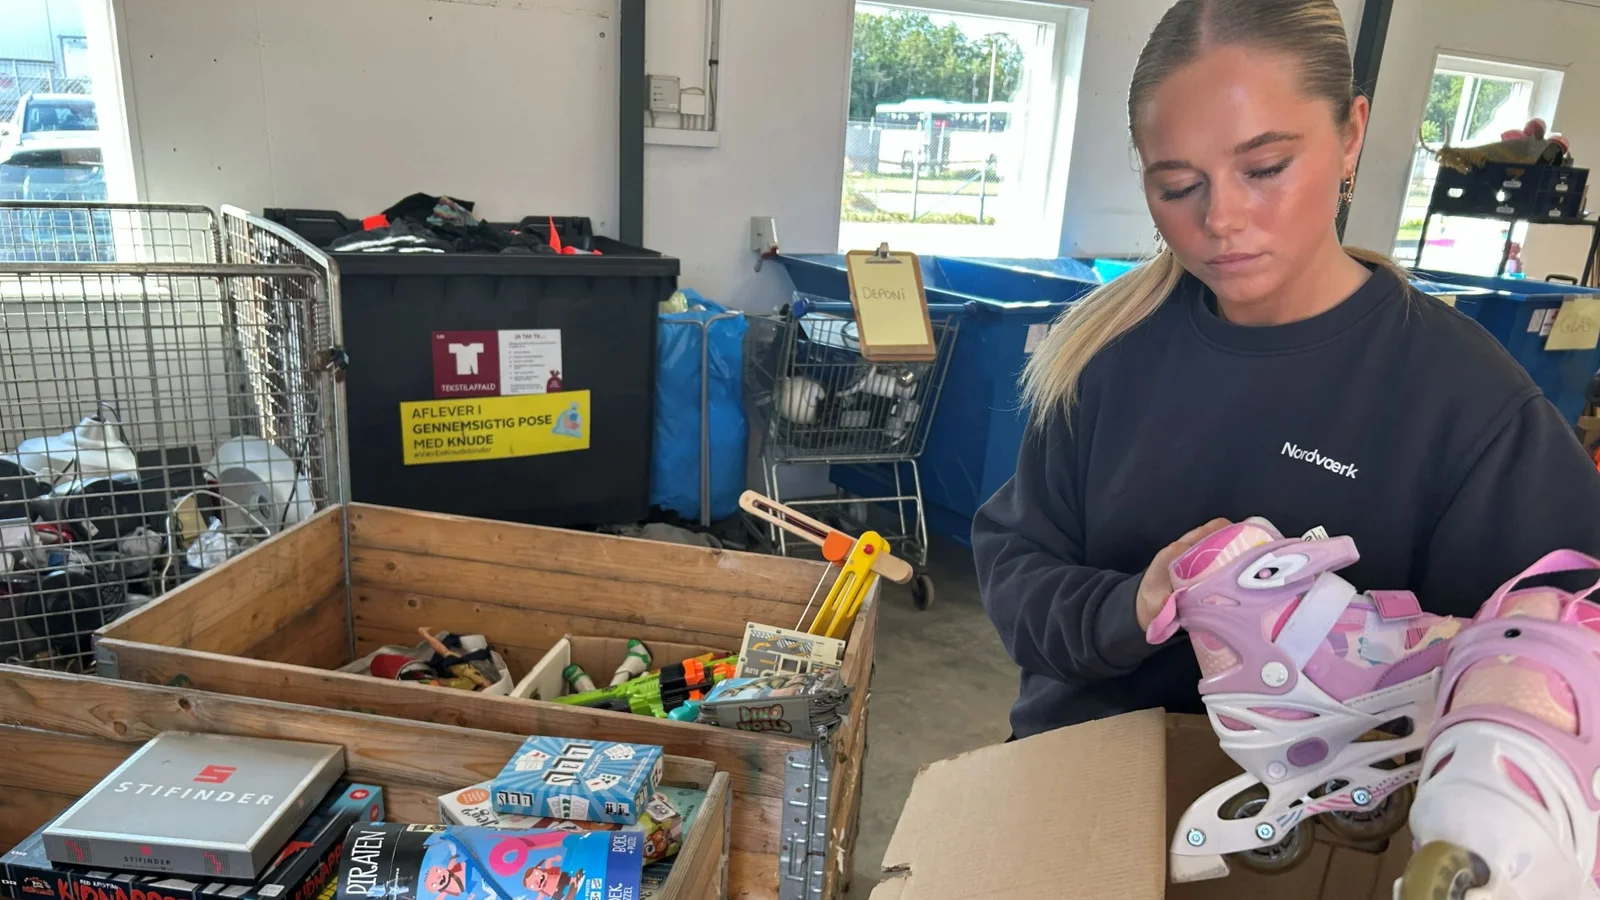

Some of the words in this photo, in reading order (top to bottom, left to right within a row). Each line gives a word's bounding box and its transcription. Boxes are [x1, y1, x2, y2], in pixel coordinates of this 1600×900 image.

[441, 382, 496, 392] TEKSTILAFFALD
[411, 405, 475, 419] AFLEVER
[478, 404, 482, 415] I
[412, 418, 515, 434] GENNEMSIGTIG
[518, 414, 553, 427] POSE
[413, 438, 444, 450] MED
[447, 434, 494, 448] KNUDE
[1281, 442, 1358, 479] Nordværk
[739, 703, 784, 722] DINO
[736, 719, 793, 734] WORLD
[114, 781, 274, 805] STIFINDER
[497, 792, 530, 807] SET
[612, 834, 627, 852] BOEK
[124, 856, 171, 865] STIFINDER
[345, 830, 387, 895] PIRATEN
